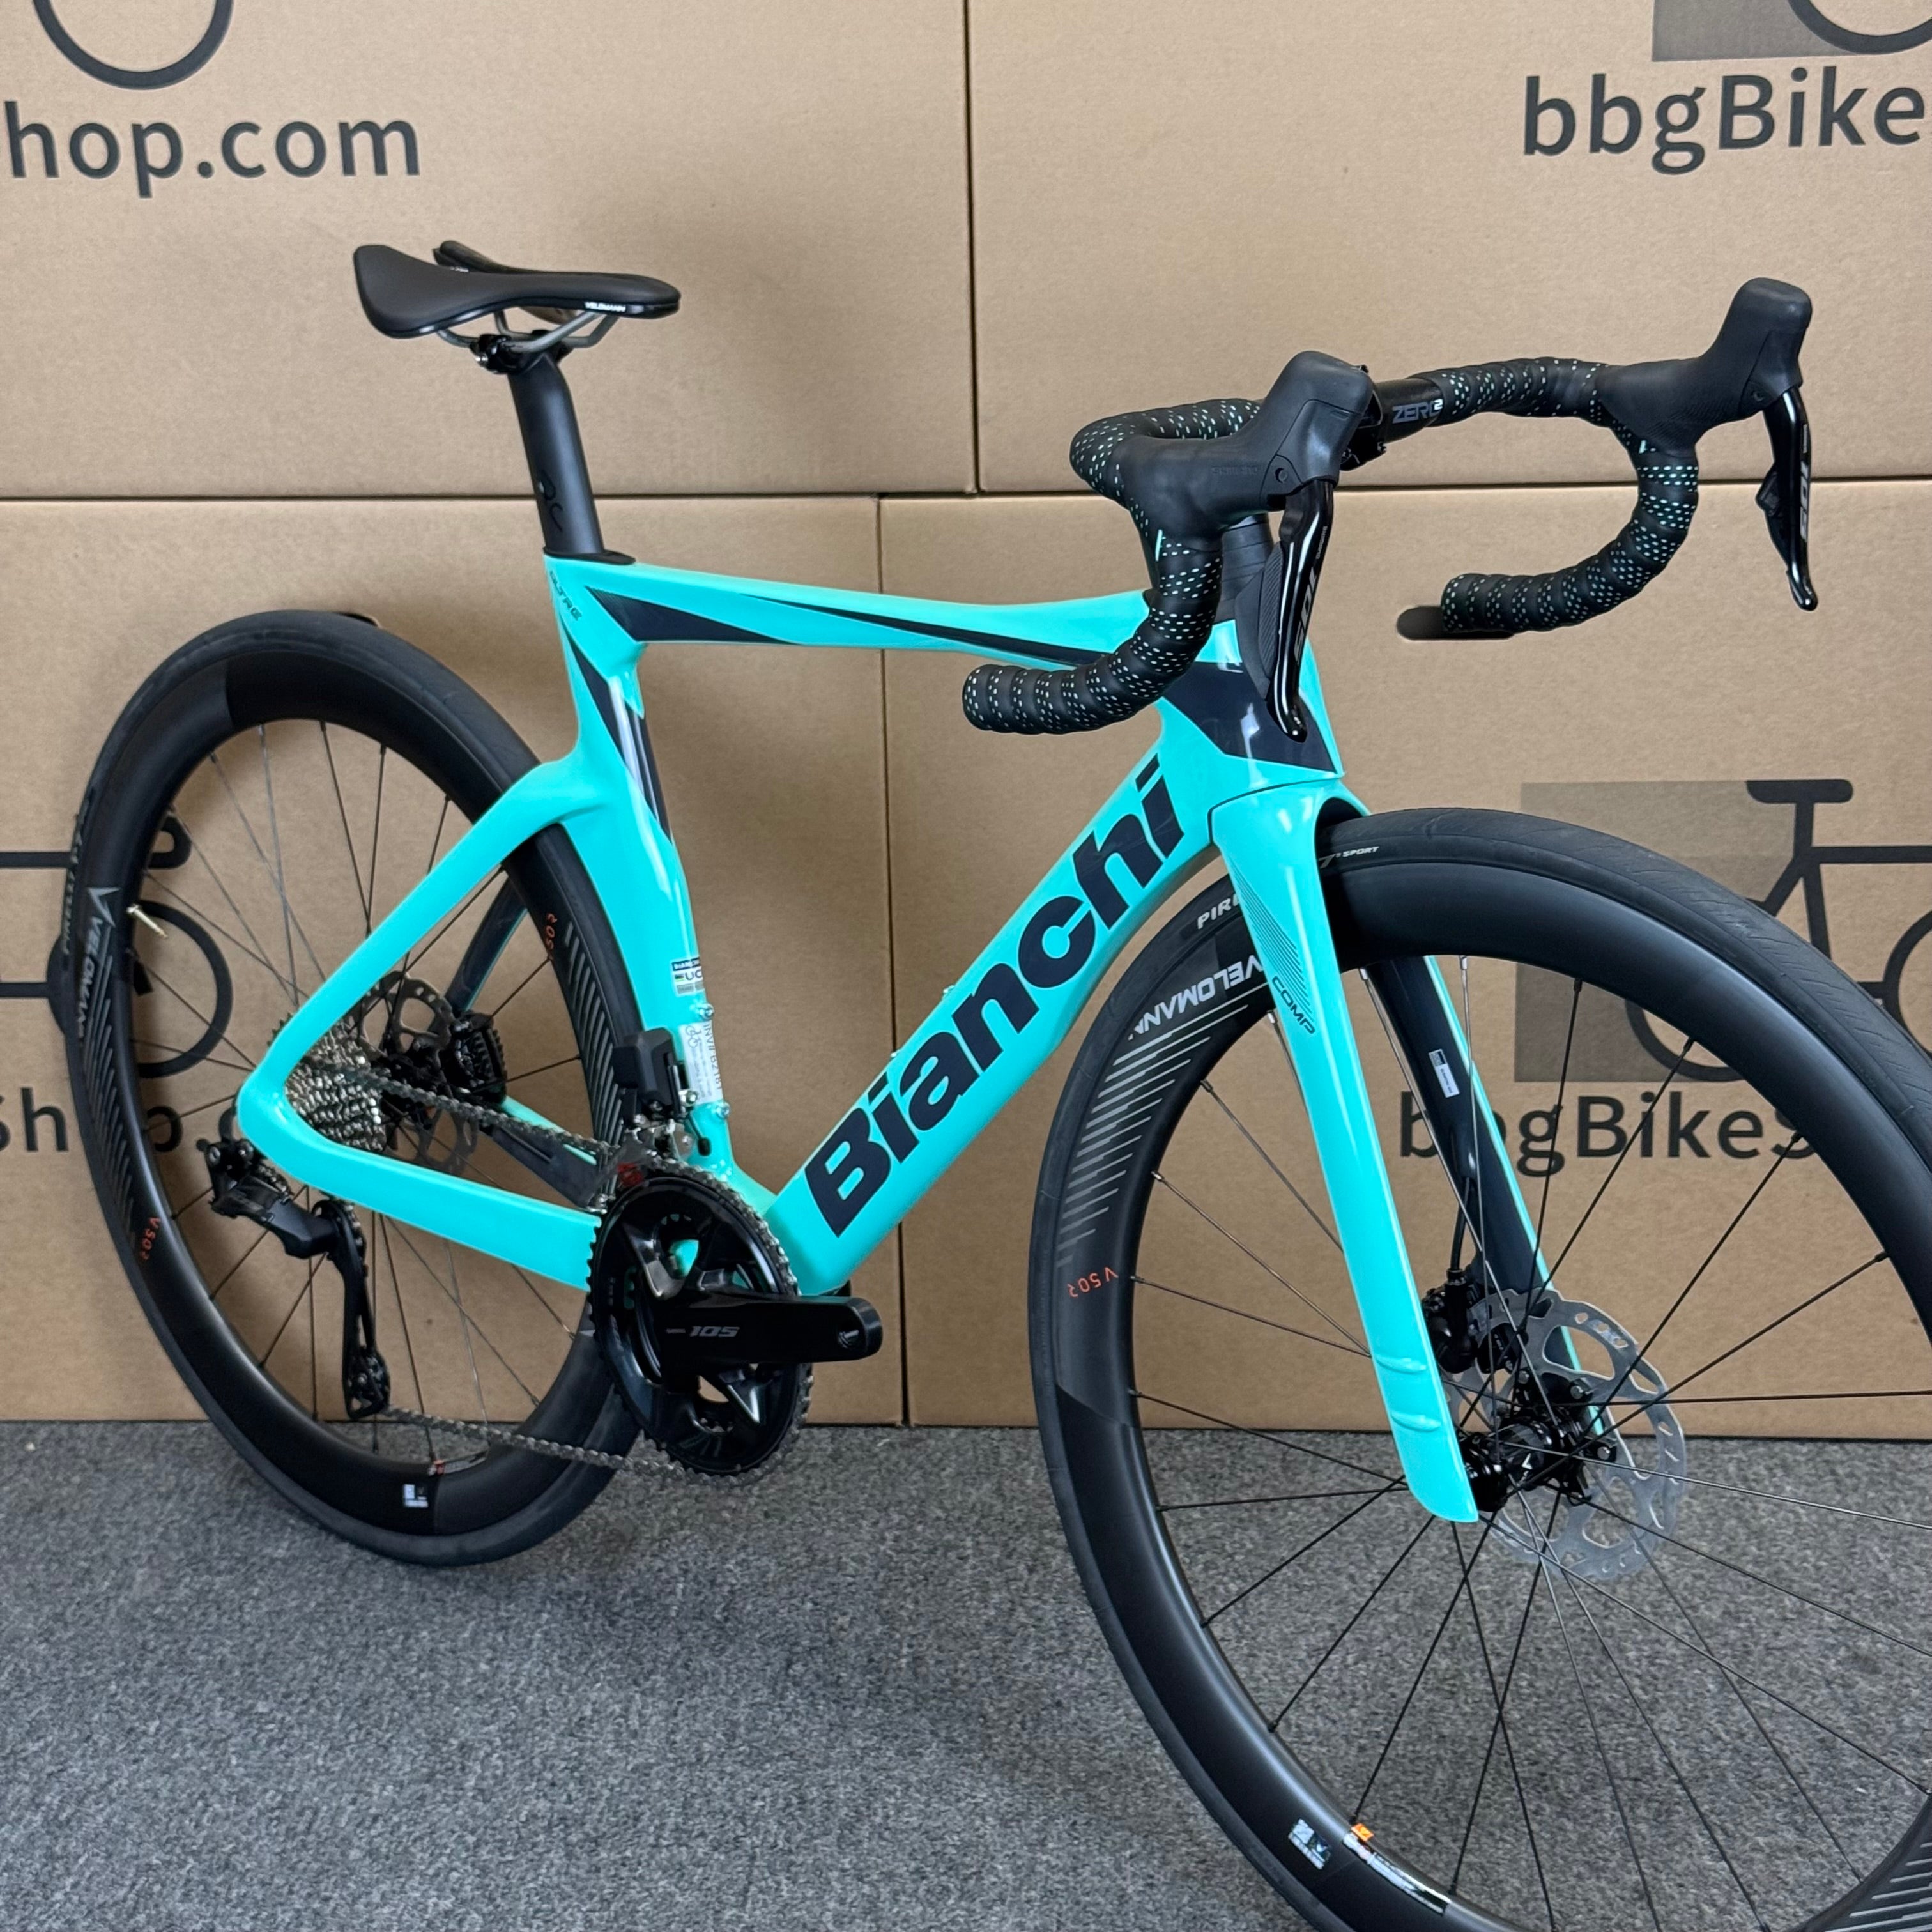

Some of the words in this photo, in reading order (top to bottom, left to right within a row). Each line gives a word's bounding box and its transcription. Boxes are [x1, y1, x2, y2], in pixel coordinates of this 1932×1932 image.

[4, 100, 420, 199] hop.com
[1524, 66, 1926, 175] bbgBike
[804, 753, 1184, 1238] Bianchi
[1272, 976, 1316, 1034] COMP
[1400, 1091, 1814, 1177] bgBike
[690, 1326, 740, 1337] 105
